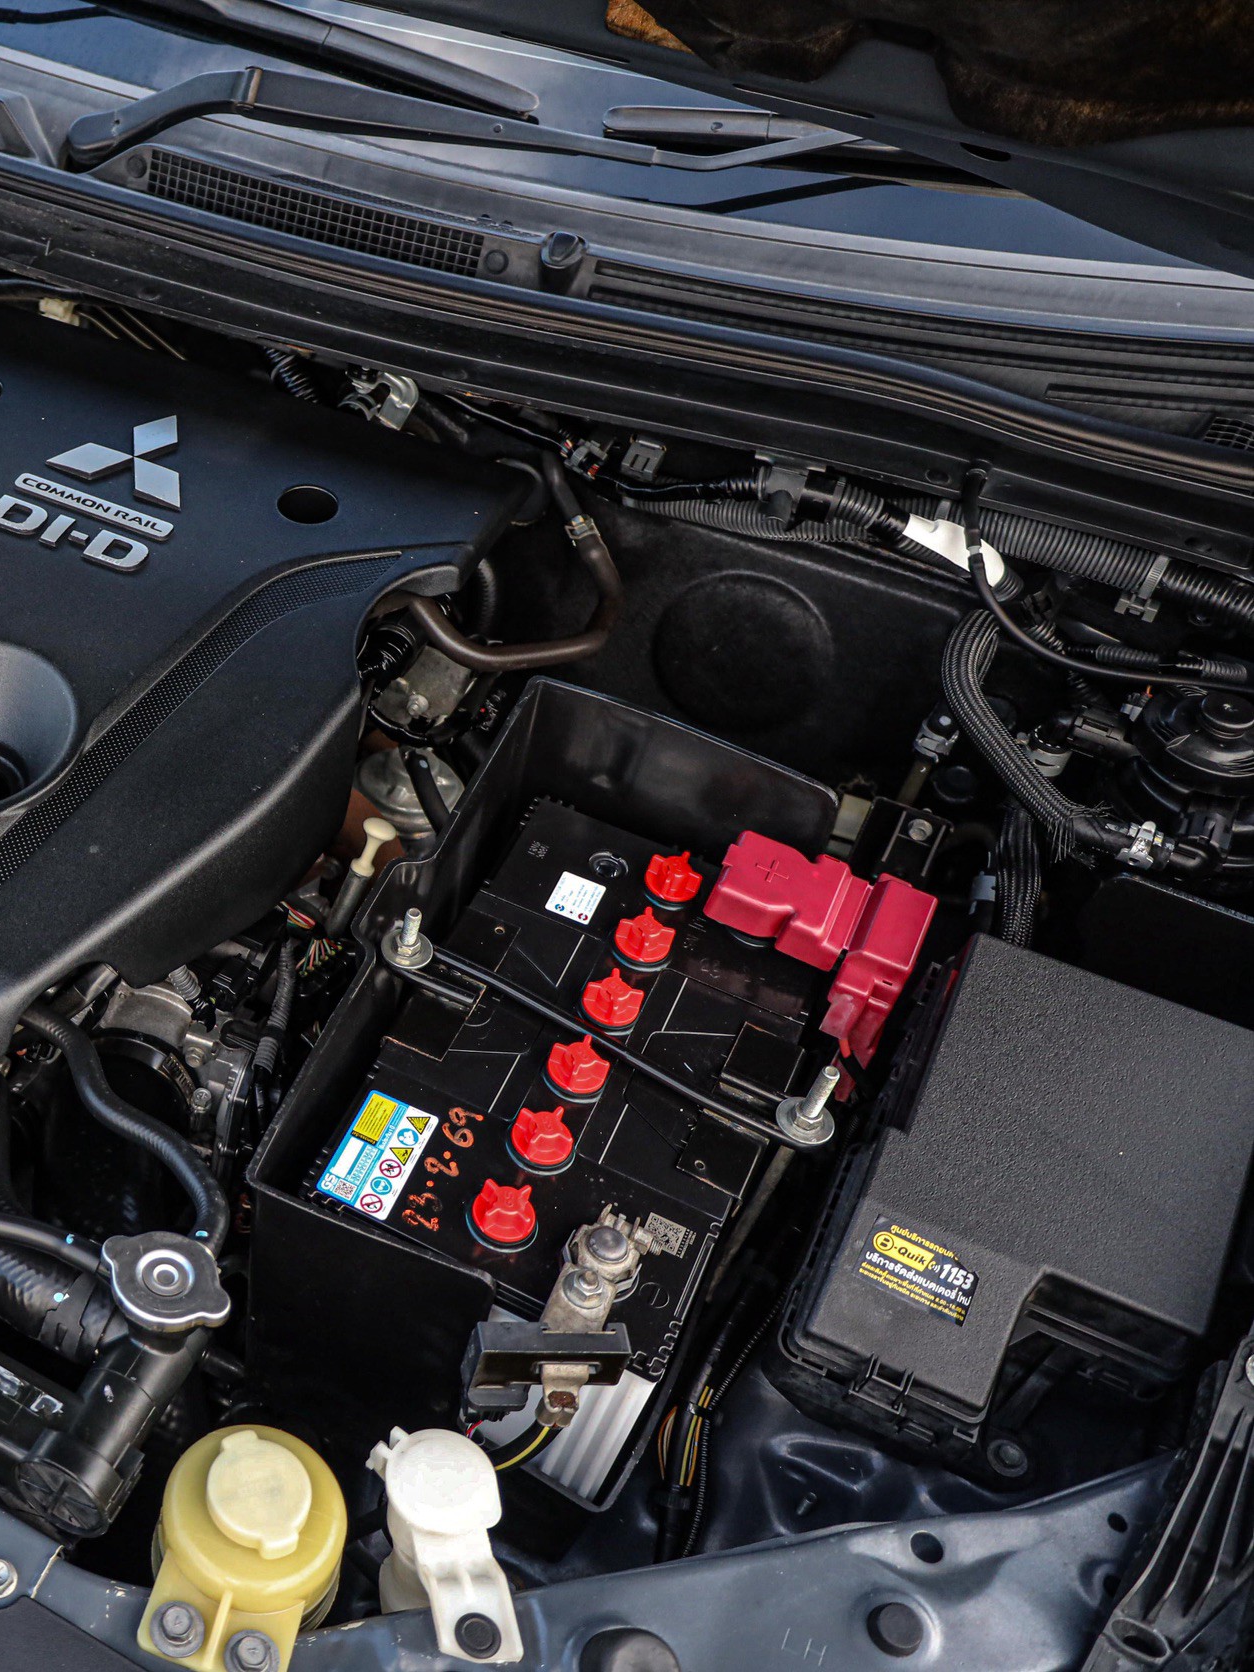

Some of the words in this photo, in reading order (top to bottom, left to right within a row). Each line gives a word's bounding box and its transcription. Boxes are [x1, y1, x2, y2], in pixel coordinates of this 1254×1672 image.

[22, 477, 110, 513] COMMON
[114, 509, 162, 532] RAIL
[320, 1172, 336, 1190] GS
[876, 1234, 928, 1266] B-Quik
[940, 1263, 974, 1290] 1153
